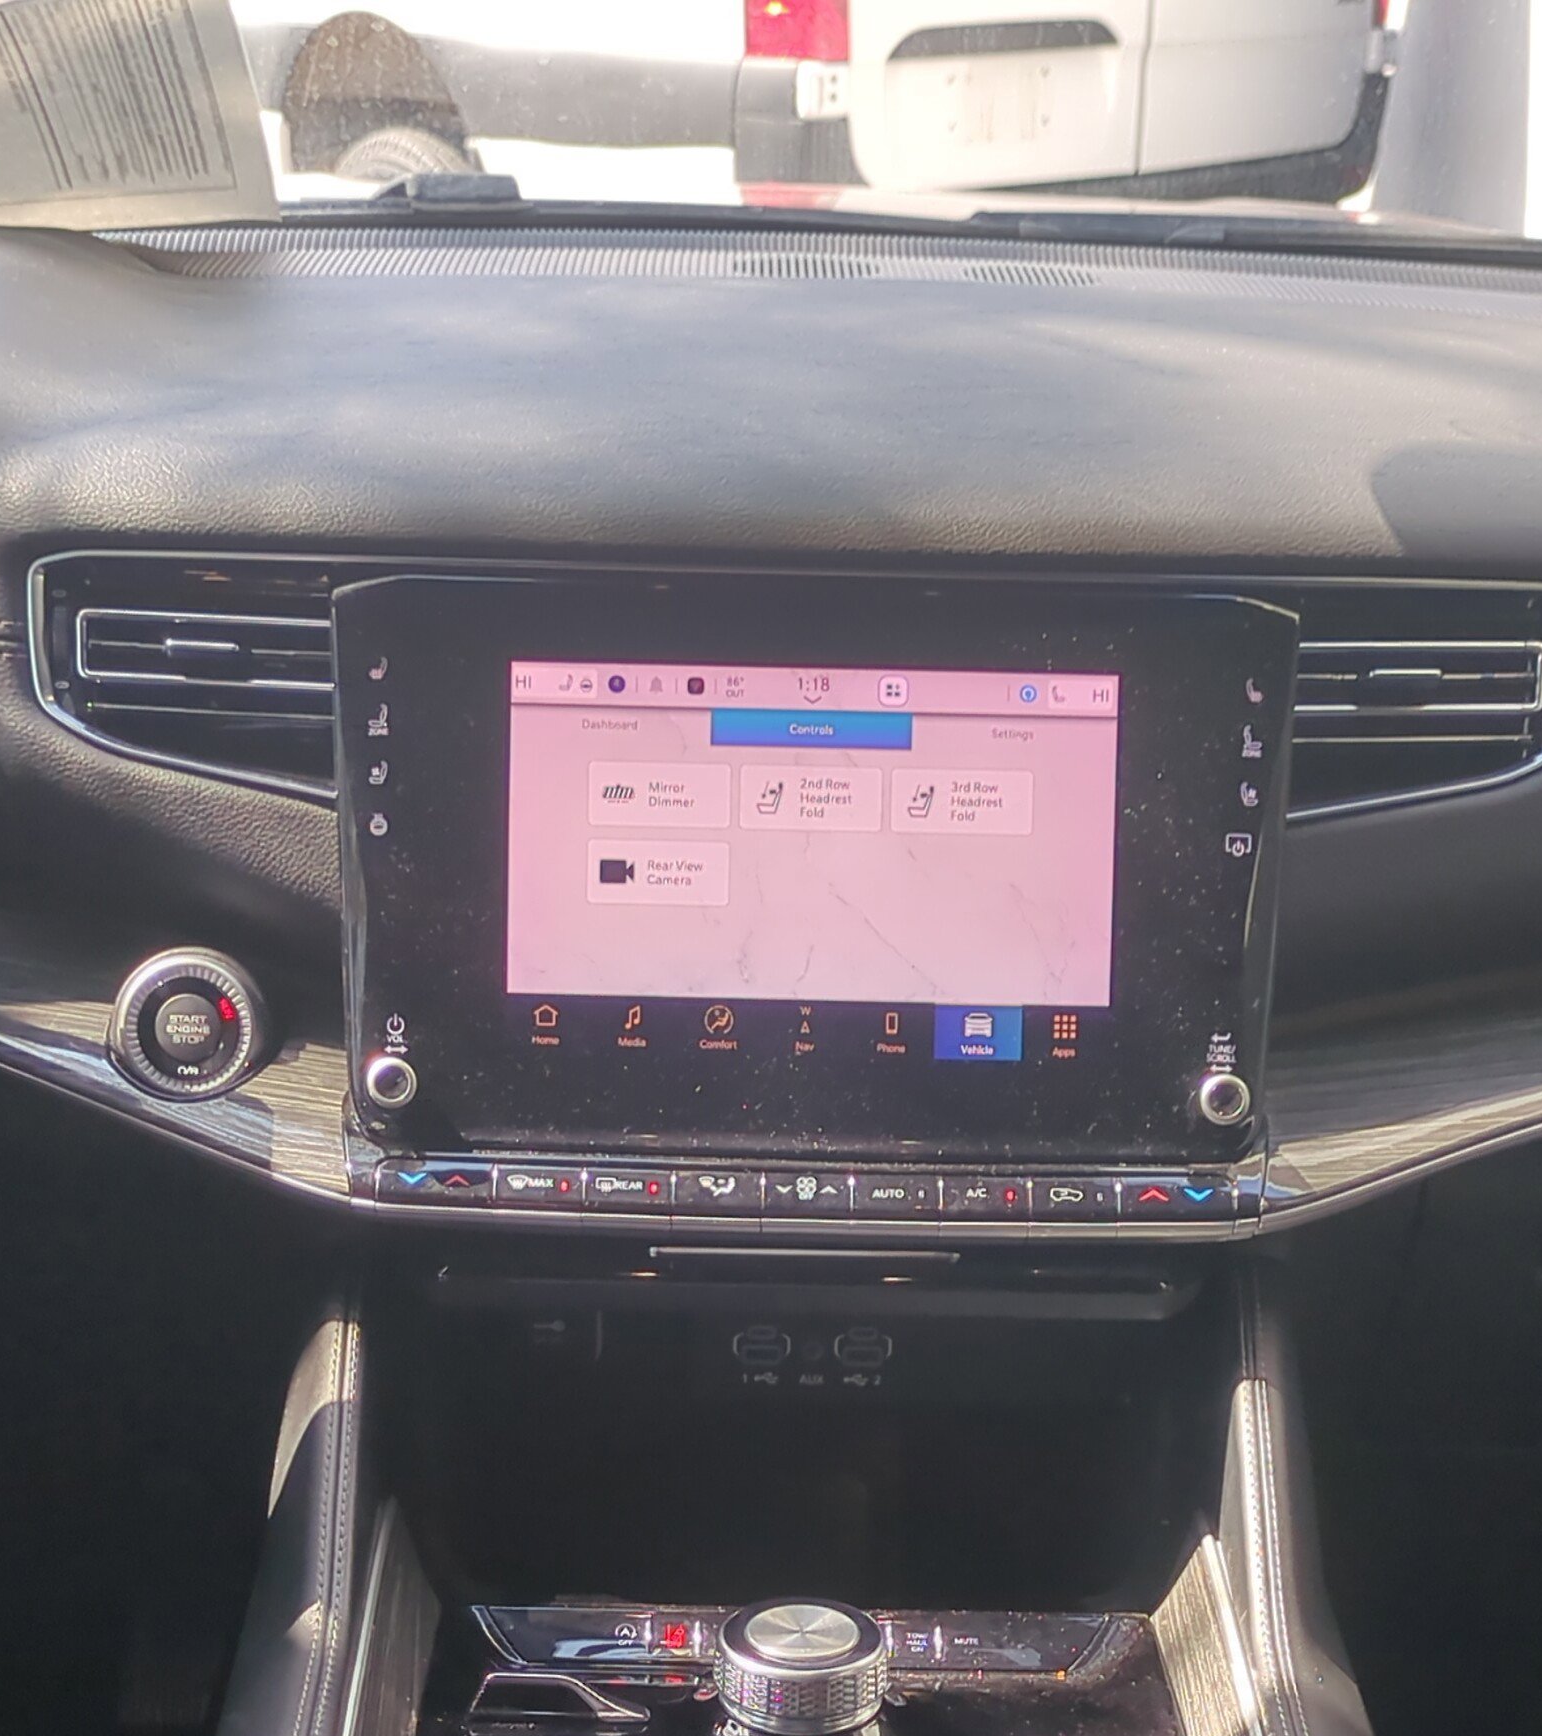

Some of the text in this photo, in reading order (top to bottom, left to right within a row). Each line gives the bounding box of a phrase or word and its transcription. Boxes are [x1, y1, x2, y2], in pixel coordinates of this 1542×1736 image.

[514, 674, 533, 689] HI
[797, 675, 831, 693] 1:18
[725, 688, 745, 698] OUT
[1091, 688, 1110, 704] HI
[581, 717, 638, 731] Dashboard
[789, 722, 834, 736] Controls
[991, 727, 1034, 741] Settings
[648, 781, 685, 794] Mirror
[800, 777, 851, 791] 2nd Row
[951, 782, 999, 795] 3rd Row
[648, 796, 695, 809] Dimmer
[800, 793, 852, 805] Headrest
[951, 796, 1003, 809] Headrest
[799, 806, 825, 819] Fold
[950, 809, 976, 822] Fold
[647, 860, 704, 873] Rear View
[647, 874, 692, 887] Camera
[169, 1014, 207, 1024] START
[166, 1025, 210, 1034] ENGINE
[171, 1035, 204, 1044] STOP
[386, 1034, 404, 1043] VOL
[531, 1035, 560, 1046] Home
[617, 1037, 647, 1048] Media
[699, 1038, 738, 1050] Comfort
[795, 1041, 815, 1052] Nav
[876, 1043, 906, 1054] Phone
[960, 1044, 994, 1055] Vehicle
[1052, 1047, 1076, 1058] Apps
[1206, 1053, 1237, 1063] SCROLL
[528, 1178, 555, 1188] MAX
[614, 1180, 643, 1190] REAR
[871, 1188, 905, 1199] AUTO
[965, 1188, 987, 1198] A/C
[954, 1637, 979, 1646] MUTE
